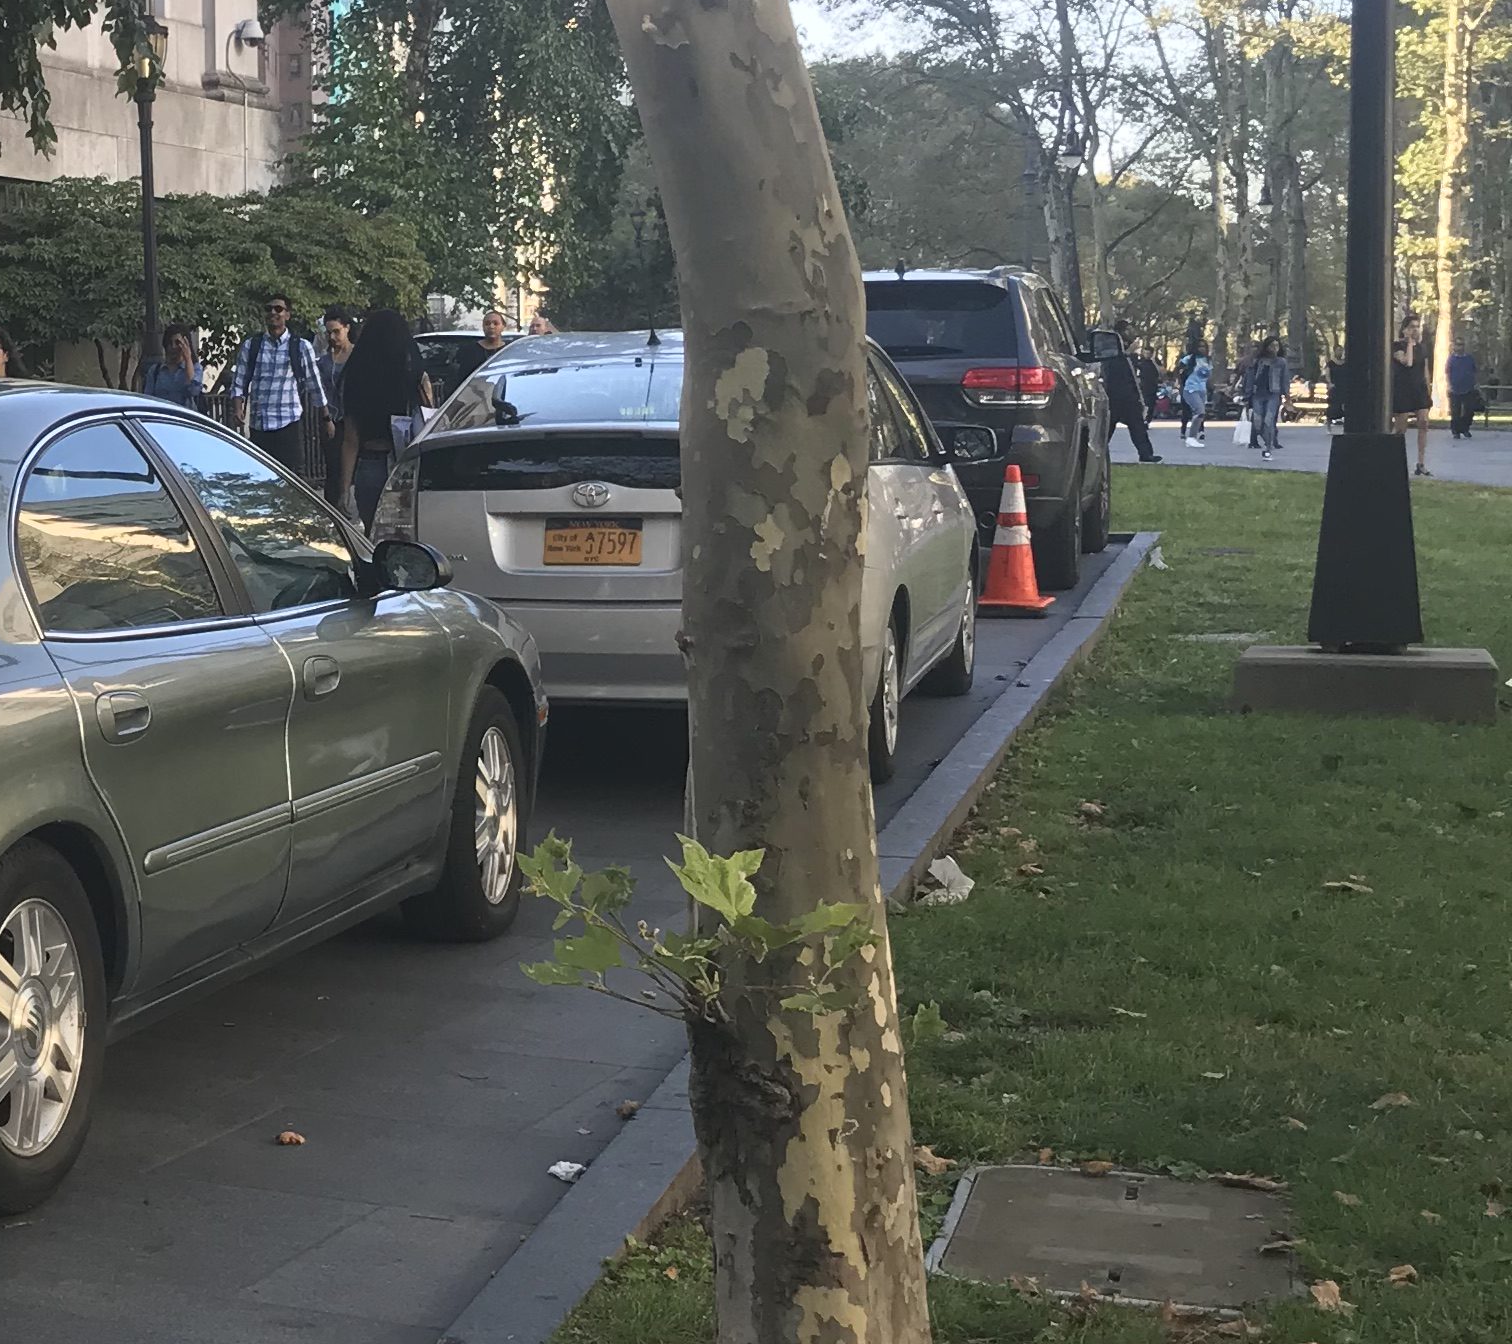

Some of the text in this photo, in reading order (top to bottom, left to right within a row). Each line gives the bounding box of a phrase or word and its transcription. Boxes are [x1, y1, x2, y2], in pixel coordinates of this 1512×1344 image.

[569, 520, 620, 529] NEW YORK
[598, 531, 638, 555] 7597
